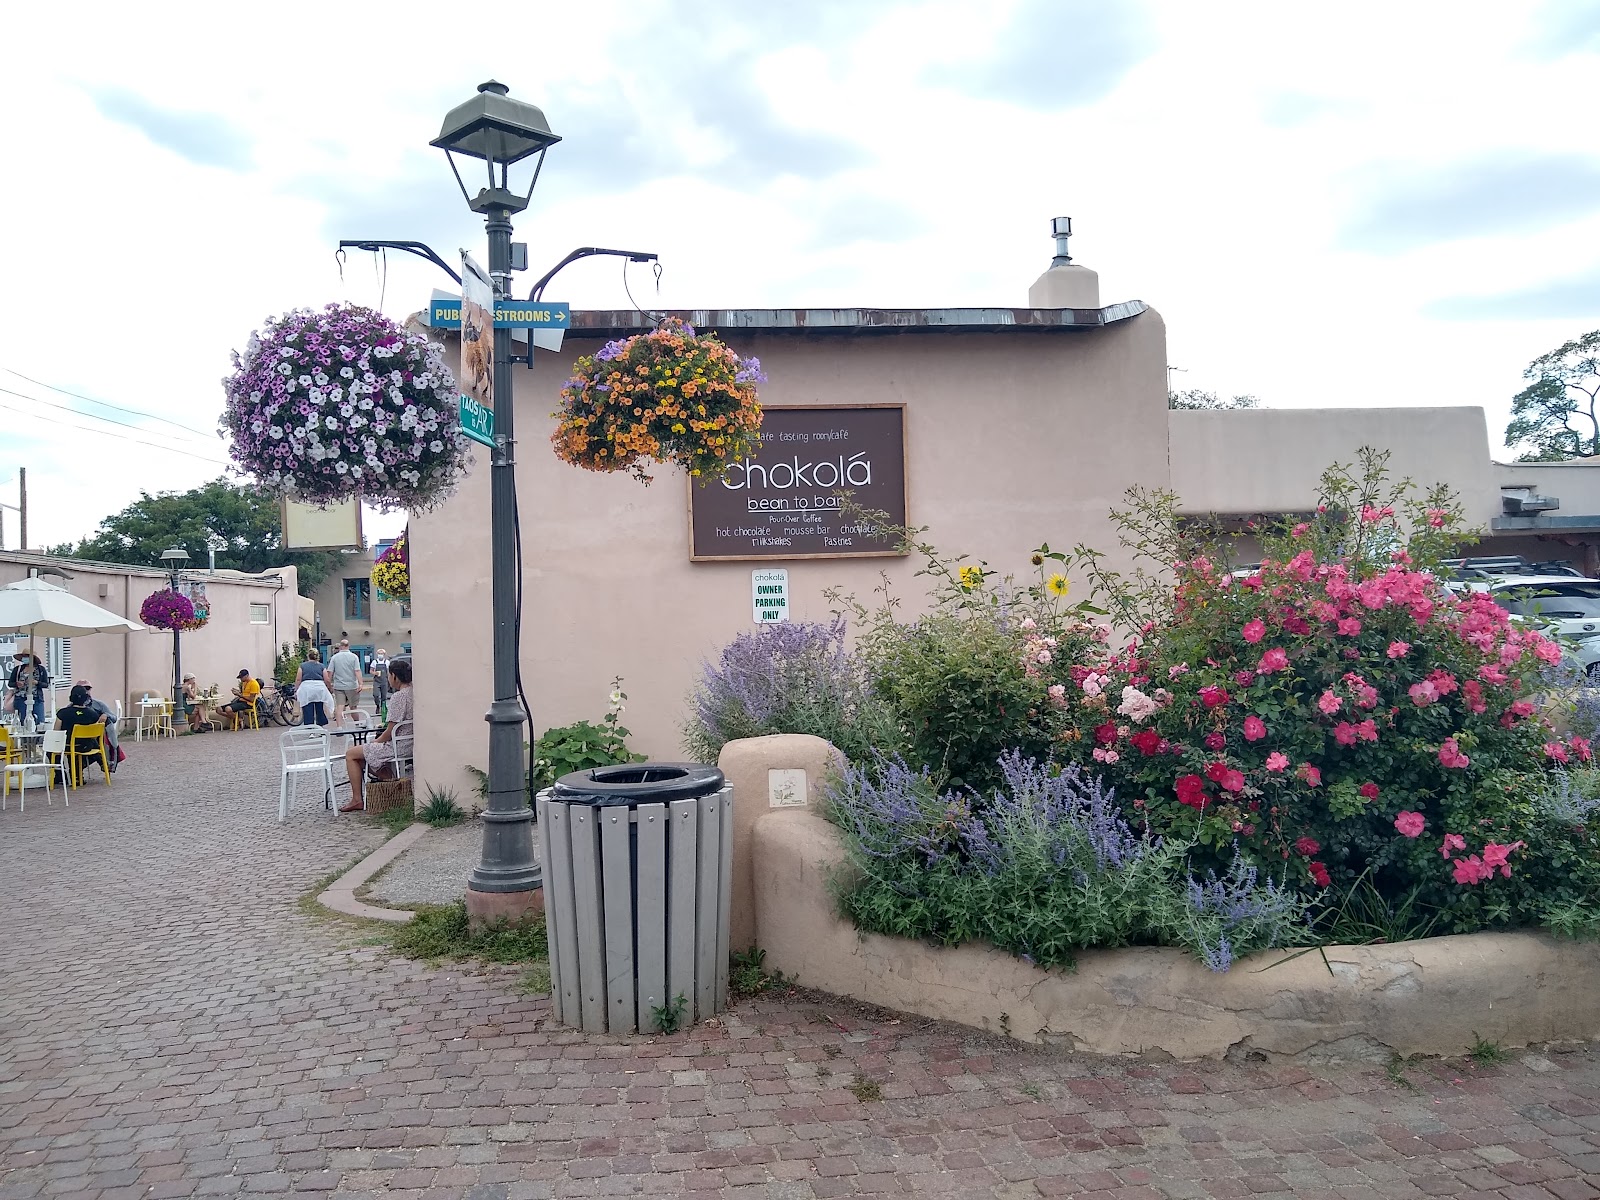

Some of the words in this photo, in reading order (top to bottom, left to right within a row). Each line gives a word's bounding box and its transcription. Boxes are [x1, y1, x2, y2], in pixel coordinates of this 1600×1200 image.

[435, 309, 461, 320] PUB
[493, 310, 551, 322] STROOMS
[461, 393, 479, 416] TAOS
[475, 406, 494, 437] ART
[779, 431, 809, 443] tasting
[720, 451, 871, 490] chokolá
[747, 496, 789, 510] bean
[793, 495, 808, 509] to
[814, 494, 844, 508] bar
[769, 514, 800, 523] Pour-Over
[802, 513, 823, 523] Coffee
[716, 526, 731, 537] hot
[733, 525, 771, 537] chocolate
[783, 526, 814, 536] mousse
[816, 524, 831, 535] bar
[752, 536, 792, 547] milkshakes
[824, 536, 852, 547] Pastries
[755, 572, 785, 581] chokolá
[757, 585, 783, 594] OWNER
[755, 597, 786, 607] PARKING
[762, 610, 779, 620] ONLY
